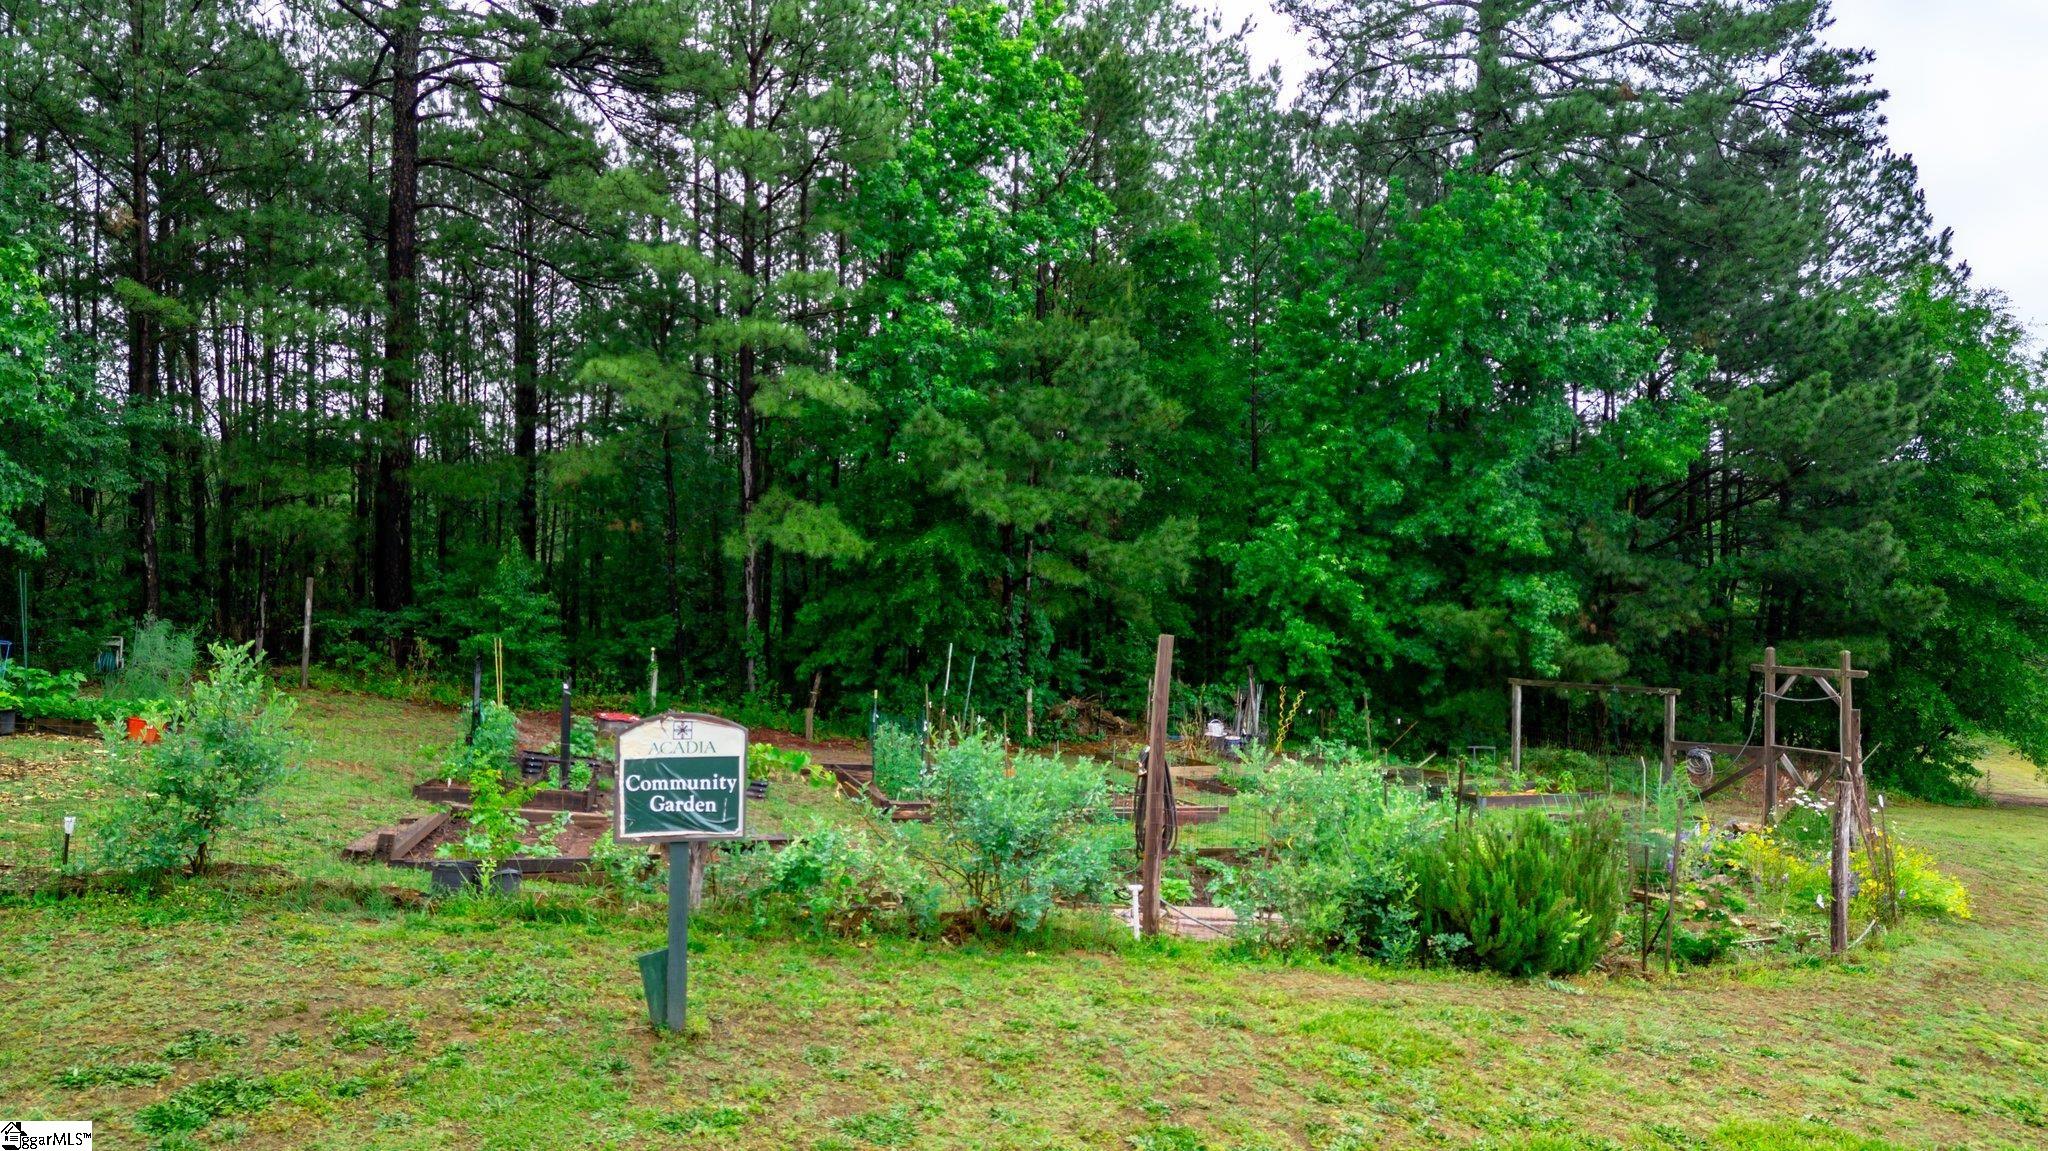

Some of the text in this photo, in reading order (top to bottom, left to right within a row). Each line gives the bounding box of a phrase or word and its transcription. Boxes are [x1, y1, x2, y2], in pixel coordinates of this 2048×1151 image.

[648, 740, 717, 755] ACADIA
[625, 773, 738, 793] Community
[649, 795, 718, 813] Garden
